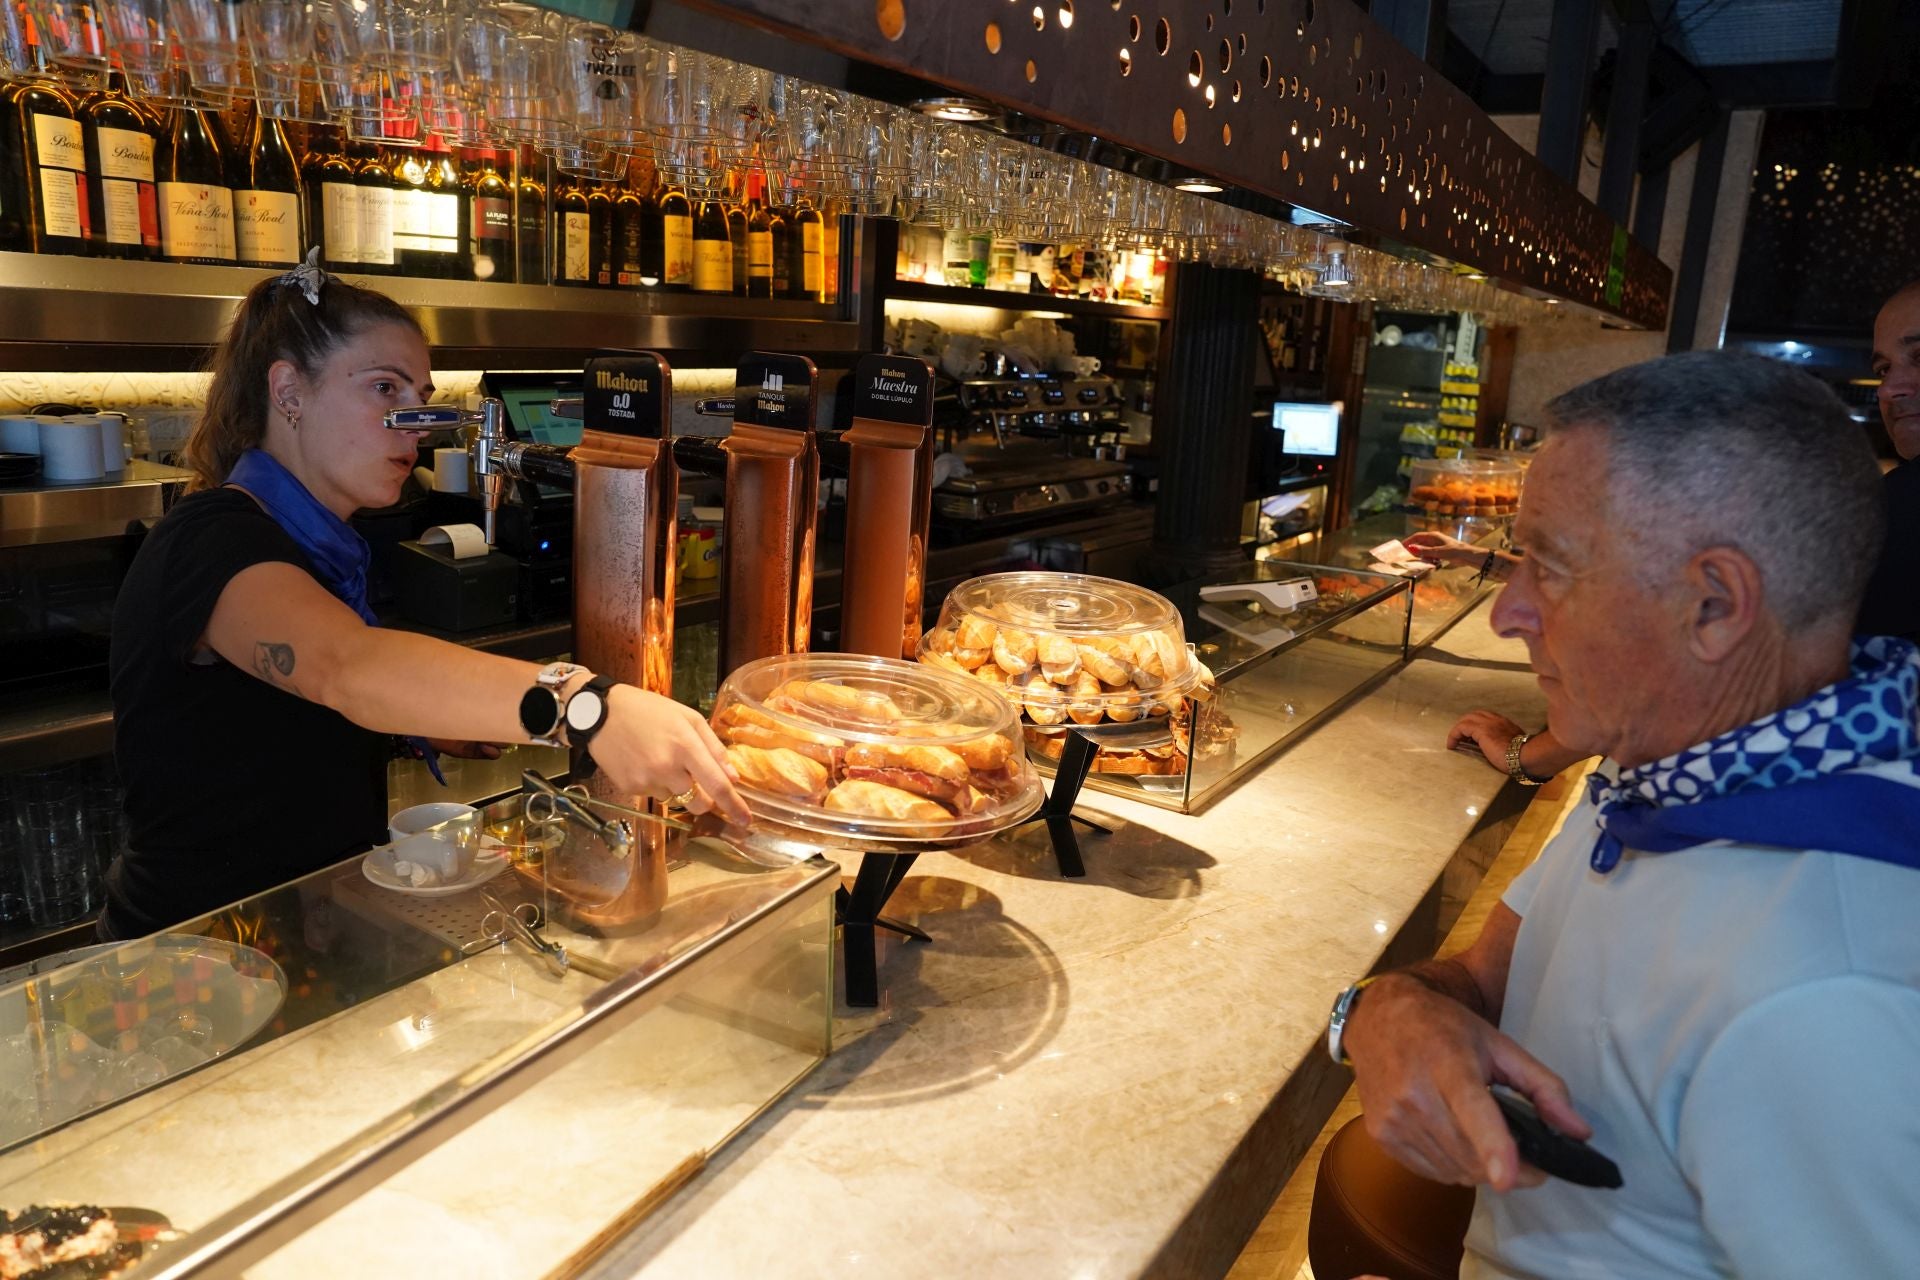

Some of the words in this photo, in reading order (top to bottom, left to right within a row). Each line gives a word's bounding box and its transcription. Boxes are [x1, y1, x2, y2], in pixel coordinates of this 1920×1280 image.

[881, 368, 906, 378] Mahou
[595, 370, 648, 393] Mahou
[868, 376, 918, 395] Maestra
[758, 391, 785, 402] TANQUE
[871, 393, 890, 401] DOBLE
[757, 400, 785, 412] Mahou
[608, 408, 635, 419] TOSTADA
